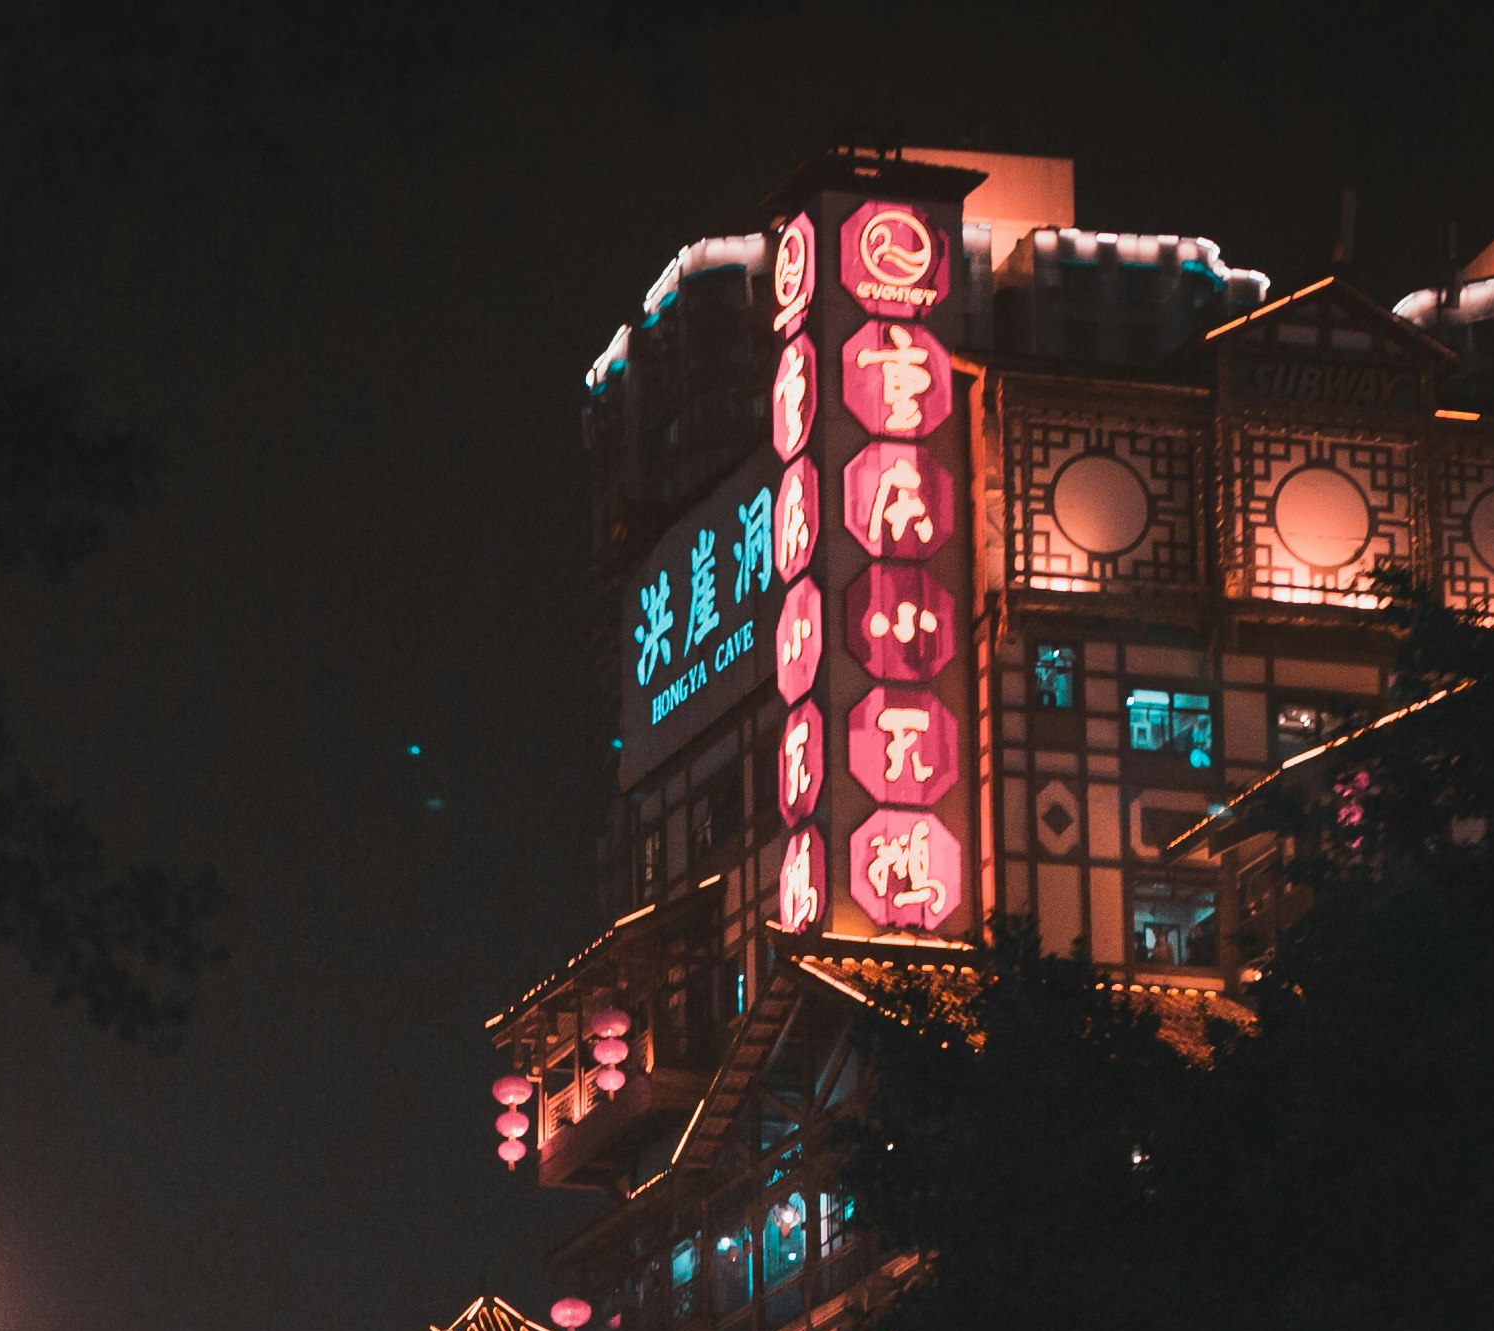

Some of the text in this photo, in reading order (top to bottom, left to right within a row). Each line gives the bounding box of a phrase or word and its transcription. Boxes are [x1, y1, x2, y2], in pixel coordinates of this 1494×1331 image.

[1250, 363, 1414, 401] SUBWAY
[634, 486, 773, 687] 洪崖洞
[651, 619, 754, 726] HONGYA CAVE
